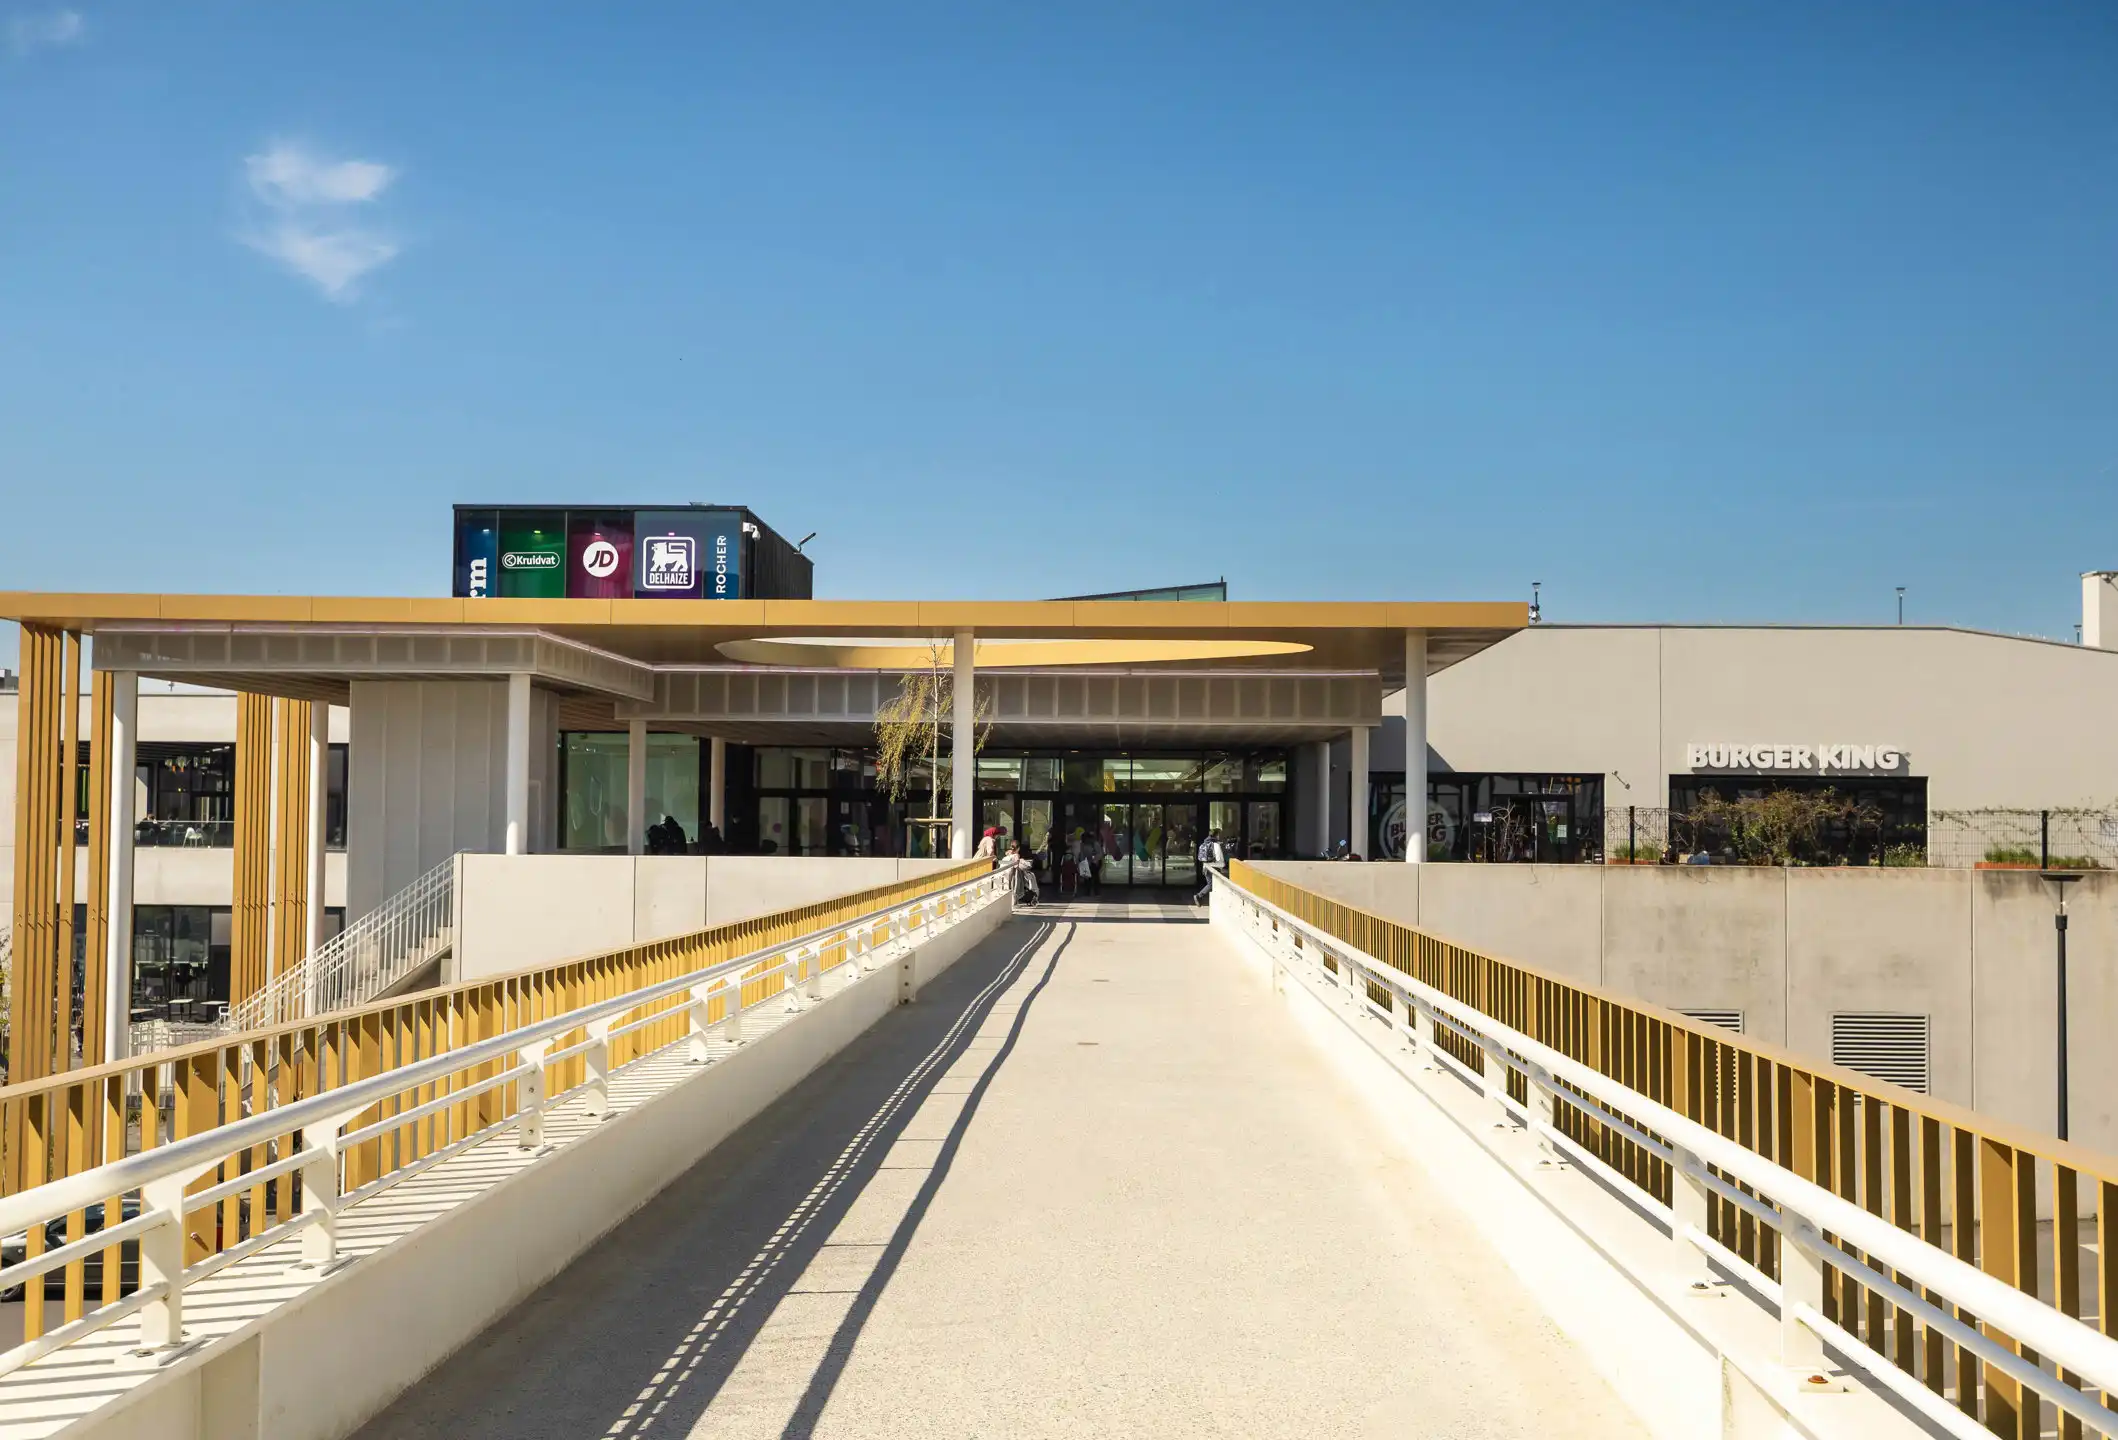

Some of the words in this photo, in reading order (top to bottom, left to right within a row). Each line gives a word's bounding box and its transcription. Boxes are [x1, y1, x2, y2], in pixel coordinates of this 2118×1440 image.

[516, 555, 556, 565] Kruidvat
[589, 550, 615, 568] JD
[716, 535, 727, 594] ROCHER
[649, 573, 689, 584] DELHAIZE
[1687, 743, 1812, 769] BURGER
[1818, 743, 1900, 770] KING
